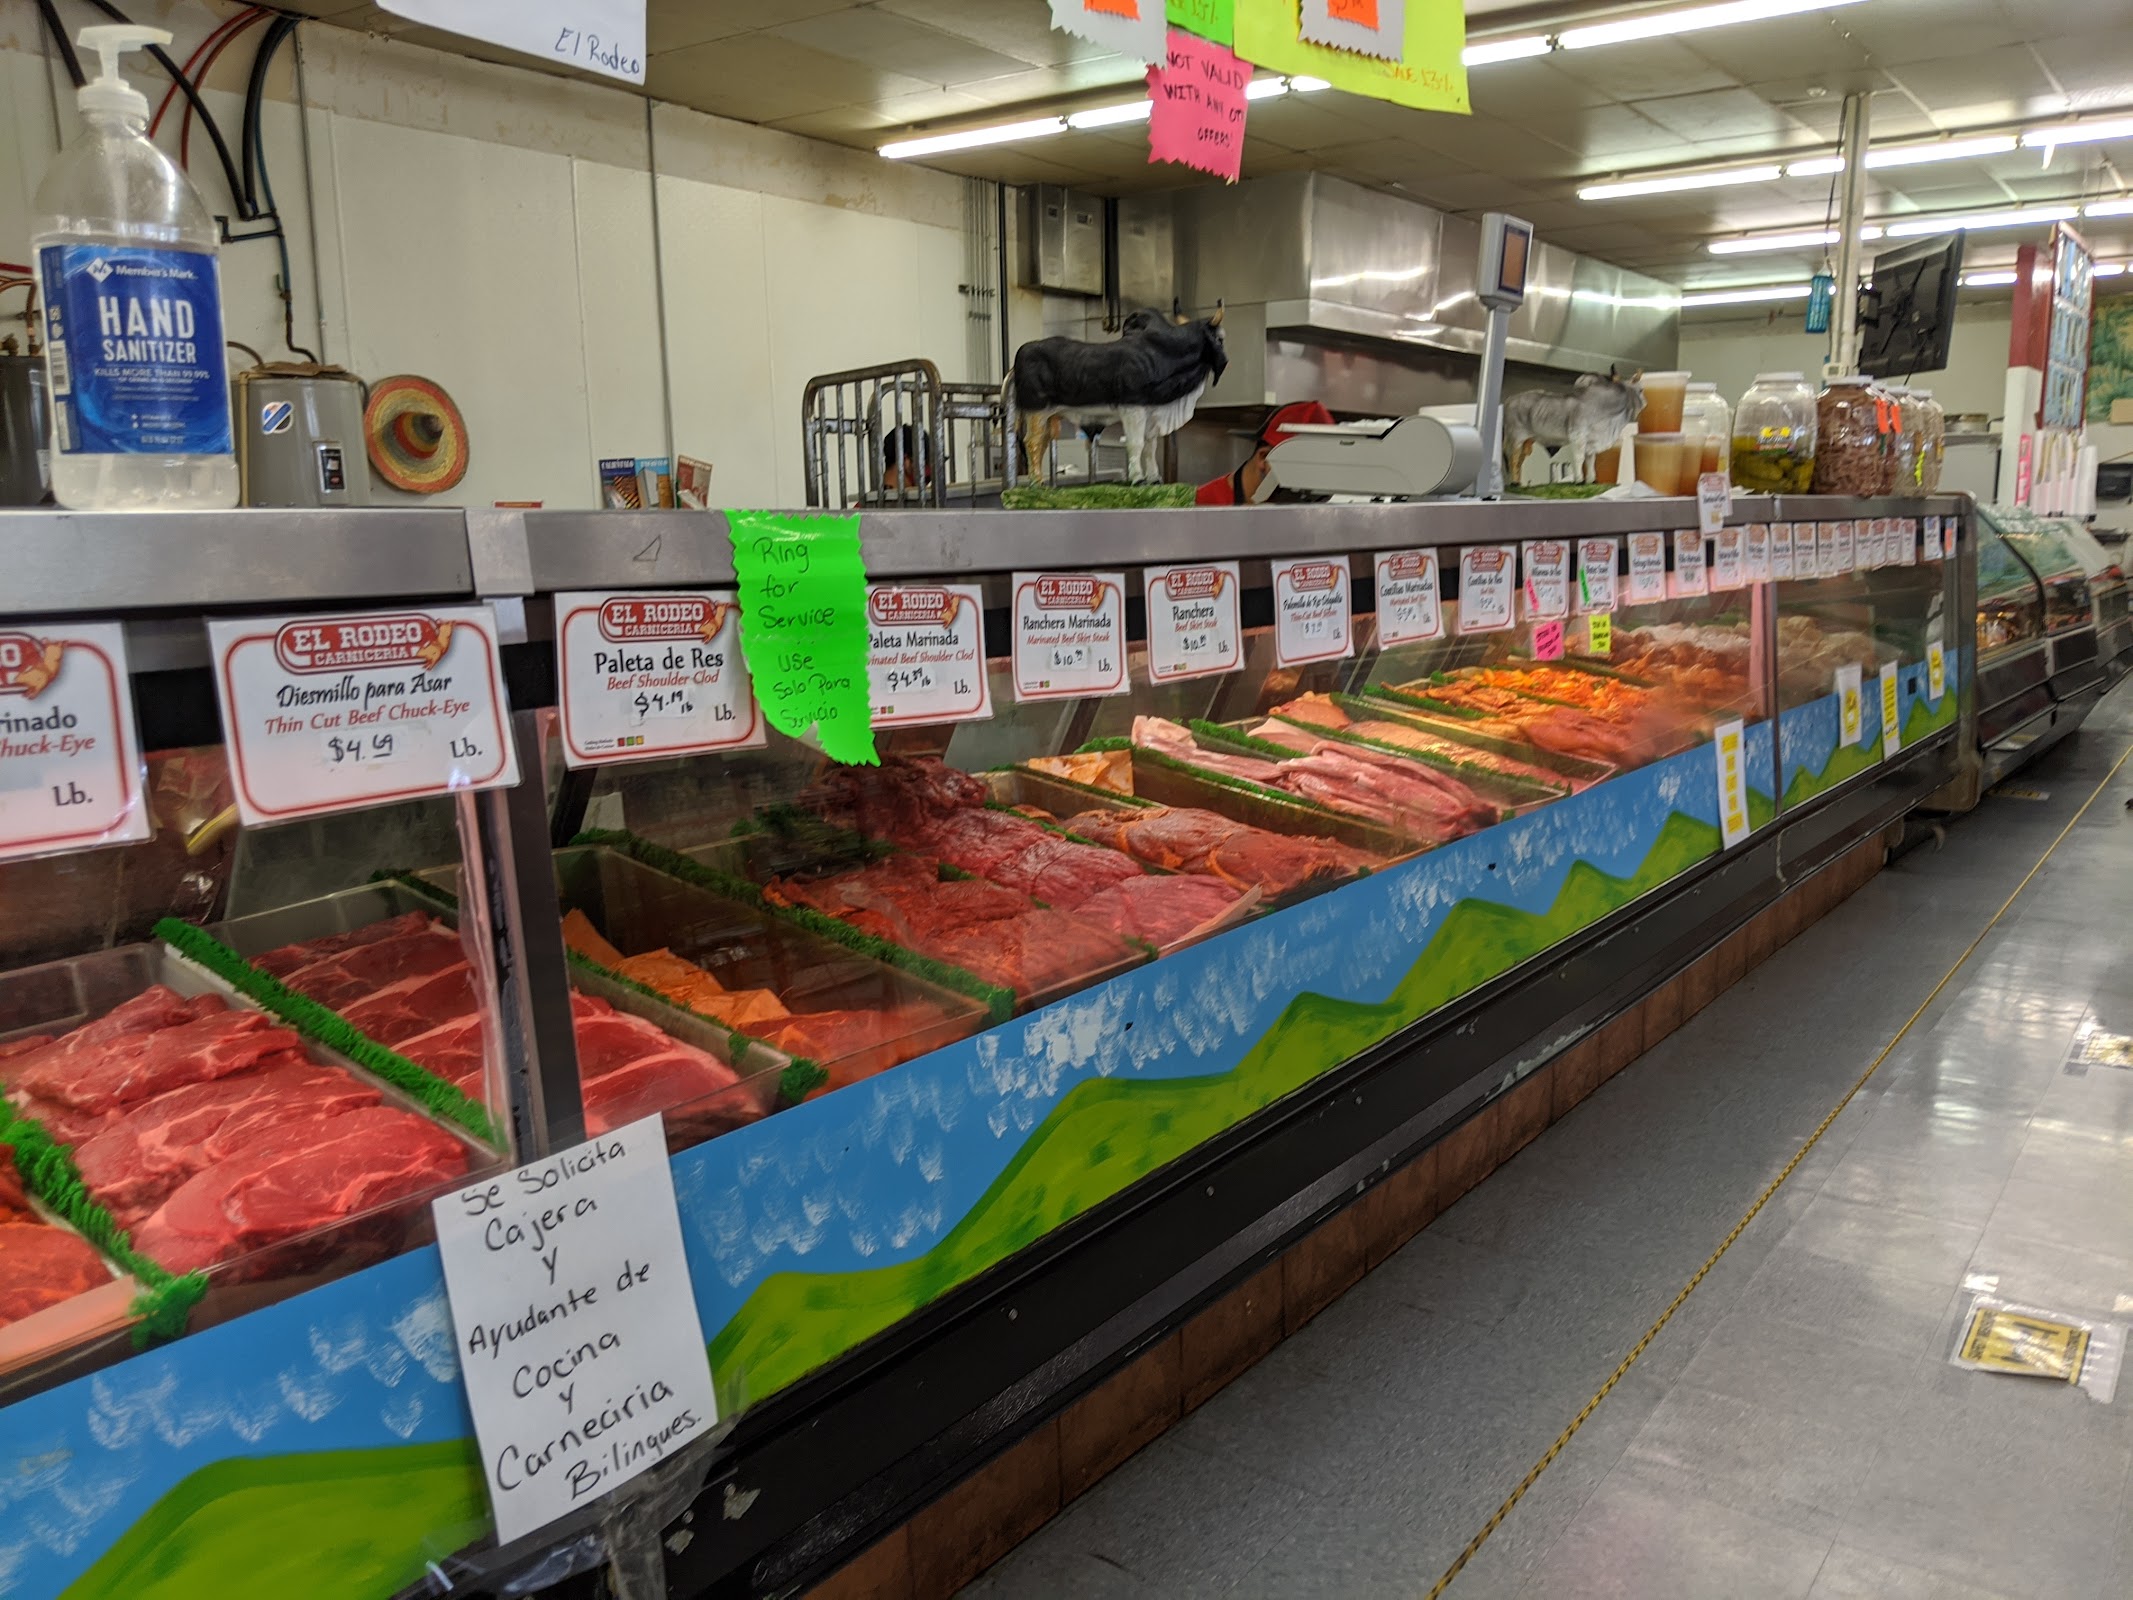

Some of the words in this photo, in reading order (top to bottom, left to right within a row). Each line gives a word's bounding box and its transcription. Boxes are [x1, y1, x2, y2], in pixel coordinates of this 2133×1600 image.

[555, 27, 581, 57] El
[587, 34, 640, 74] Rodeo
[1201, 59, 1244, 90] VALID
[1163, 83, 1200, 103] WITH
[116, 264, 169, 278] Member's
[99, 296, 195, 339] HAND
[102, 339, 197, 364] SANITIZER
[122, 369, 151, 378] MORE
[753, 537, 810, 574] Ring
[760, 574, 800, 598] for
[1041, 580, 1055, 595] EL
[1058, 580, 1093, 596] RODEO
[878, 593, 897, 610] EL
[901, 593, 944, 609] RODEO
[1172, 601, 1215, 621] Ranchera
[611, 604, 637, 624] EL
[643, 603, 704, 623] RODEO
[759, 605, 836, 629] Service
[888, 611, 936, 621] CARNICERIA
[1023, 613, 1065, 631] Ranchera
[1068, 611, 1111, 630] Marinada
[292, 627, 331, 652] EL
[339, 622, 422, 648] RODEO
[625, 624, 692, 636] CARNICERIA
[906, 629, 959, 648] Marinada
[314, 647, 409, 666] CARNICERIA
[594, 649, 654, 675] Paleta
[663, 646, 685, 670] de
[691, 647, 724, 668] Res
[901, 651, 919, 665] Beef
[920, 649, 953, 664] Shoulder
[955, 648, 975, 661] Clod
[1098, 657, 1113, 673] Lb.
[607, 674, 636, 691] Beef
[637, 672, 690, 688] Shoulder
[692, 669, 721, 685] Clod
[772, 680, 807, 701] Solo
[954, 678, 971, 695] Lb.
[277, 675, 360, 708] Diesmillo
[364, 682, 405, 710] para
[410, 673, 452, 695] Asar
[265, 718, 303, 735] Thin
[310, 712, 341, 730] Cut
[347, 705, 383, 725] Beef
[388, 699, 470, 721] Chuck-Eye
[714, 704, 736, 722] Lb.
[0, 734, 96, 757] huck-Eye
[450, 739, 483, 759] Lb.
[52, 781, 94, 807] Lb.
[462, 1187, 505, 1217] Se
[518, 1141, 626, 1195] Solicita
[485, 1198, 598, 1253] Cajera
[468, 1287, 597, 1361] Ayudante
[616, 1258, 651, 1293] de
[512, 1331, 621, 1399] Cocina
